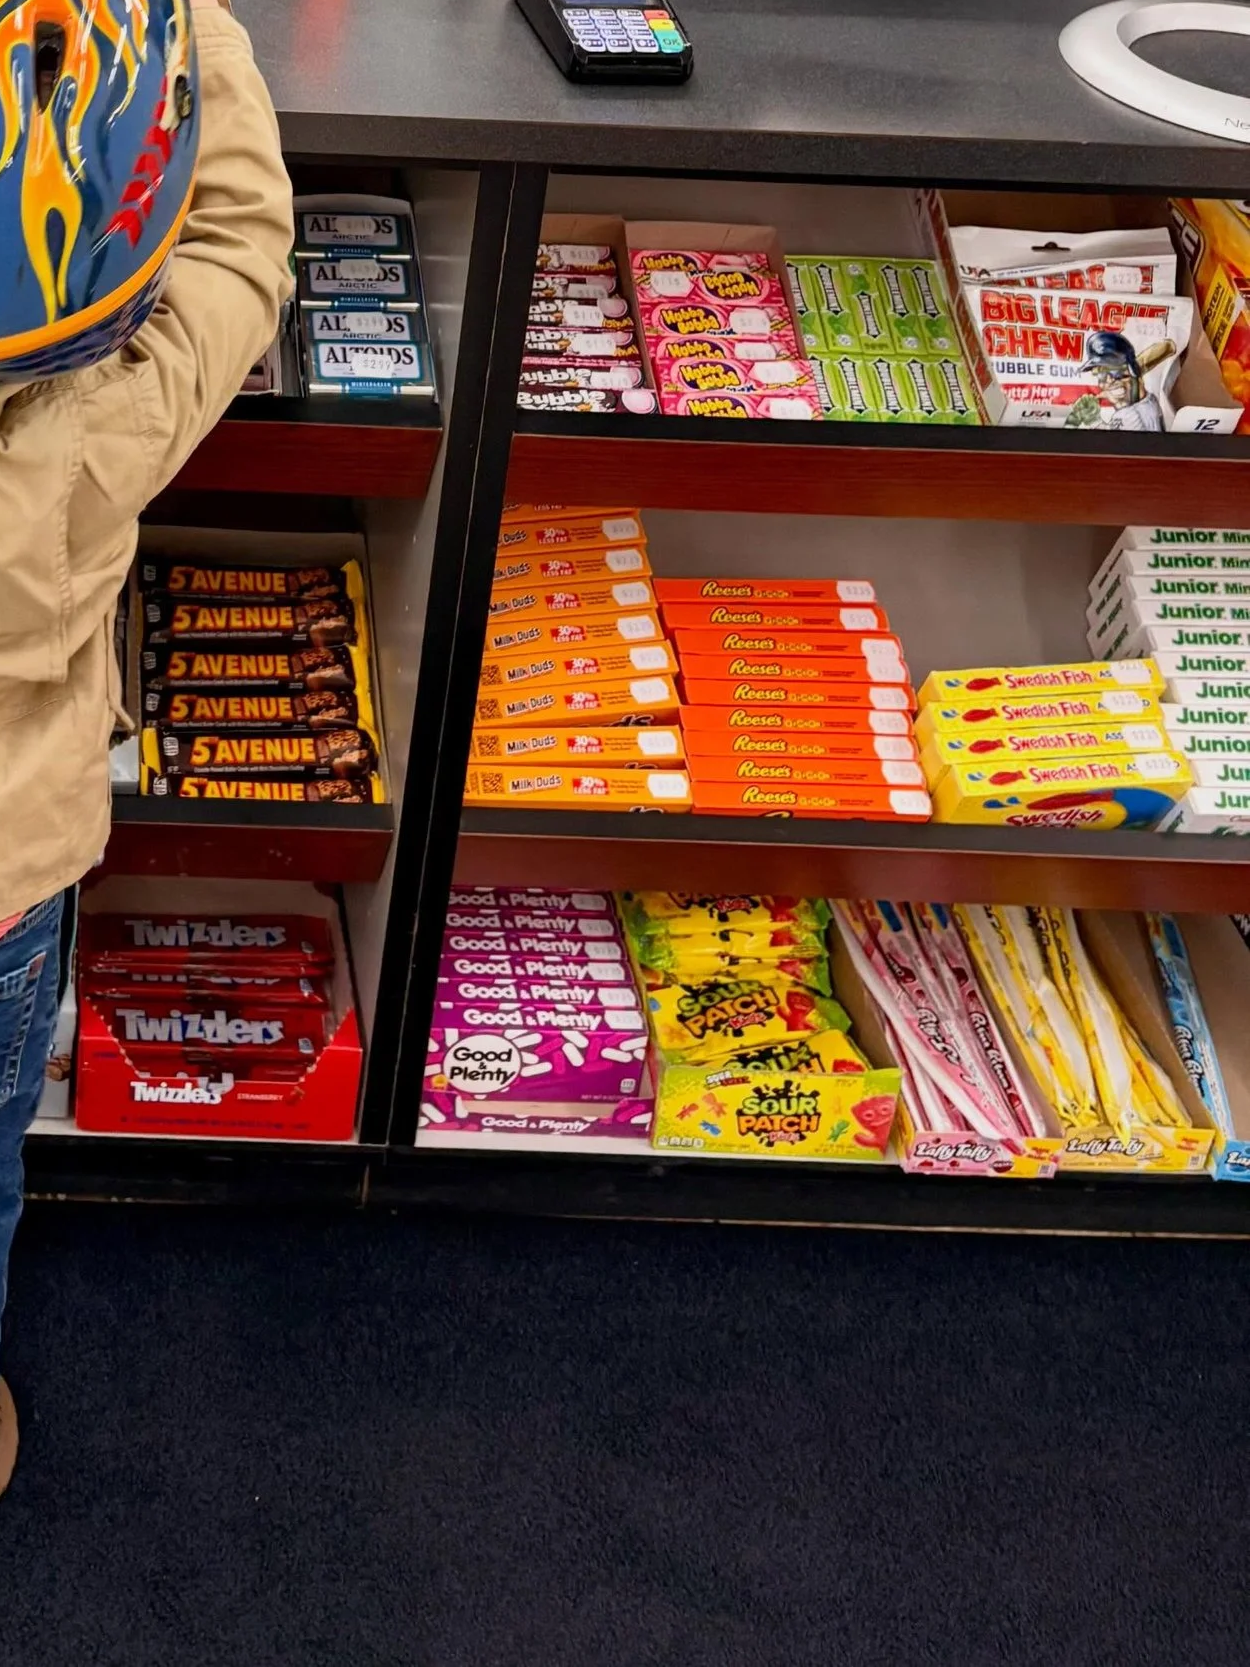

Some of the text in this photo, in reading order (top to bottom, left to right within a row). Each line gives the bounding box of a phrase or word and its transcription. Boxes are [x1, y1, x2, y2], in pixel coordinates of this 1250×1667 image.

[980, 289, 1037, 324] BIG
[982, 323, 1085, 363] CHEW
[679, 361, 724, 380] Hubba
[994, 360, 1082, 379] UBBLE GUM
[698, 371, 741, 390] Bubba
[516, 390, 606, 407] Bubble
[1195, 418, 1220, 431] 12
[1150, 527, 1250, 544] Junior Min
[1148, 552, 1215, 569] Junior
[1004, 670, 1092, 689] Swedish Fish
[734, 684, 787, 702] Reese's
[214, 738, 316, 764] AVENUE
[511, 777, 532, 790] Milk
[535, 774, 561, 787] Duds
[1028, 764, 1120, 784] Swedish Fish
[742, 785, 796, 805] Reese's
[458, 983, 595, 1004] Good & Plenty
[676, 979, 762, 1018] SOUR
[683, 985, 779, 1040] PATCH
[116, 1008, 284, 1045] Twizzlers
[453, 1046, 513, 1062] Good
[479, 1061, 488, 1070] &
[449, 1066, 516, 1085] Plenty
[130, 1081, 222, 1105] Twizzlers
[742, 1097, 818, 1116] SOUR
[737, 1114, 822, 1135] PATCH
[916, 1141, 994, 1161] Laffy Taffy
[1067, 1138, 1107, 1156] Laffy
